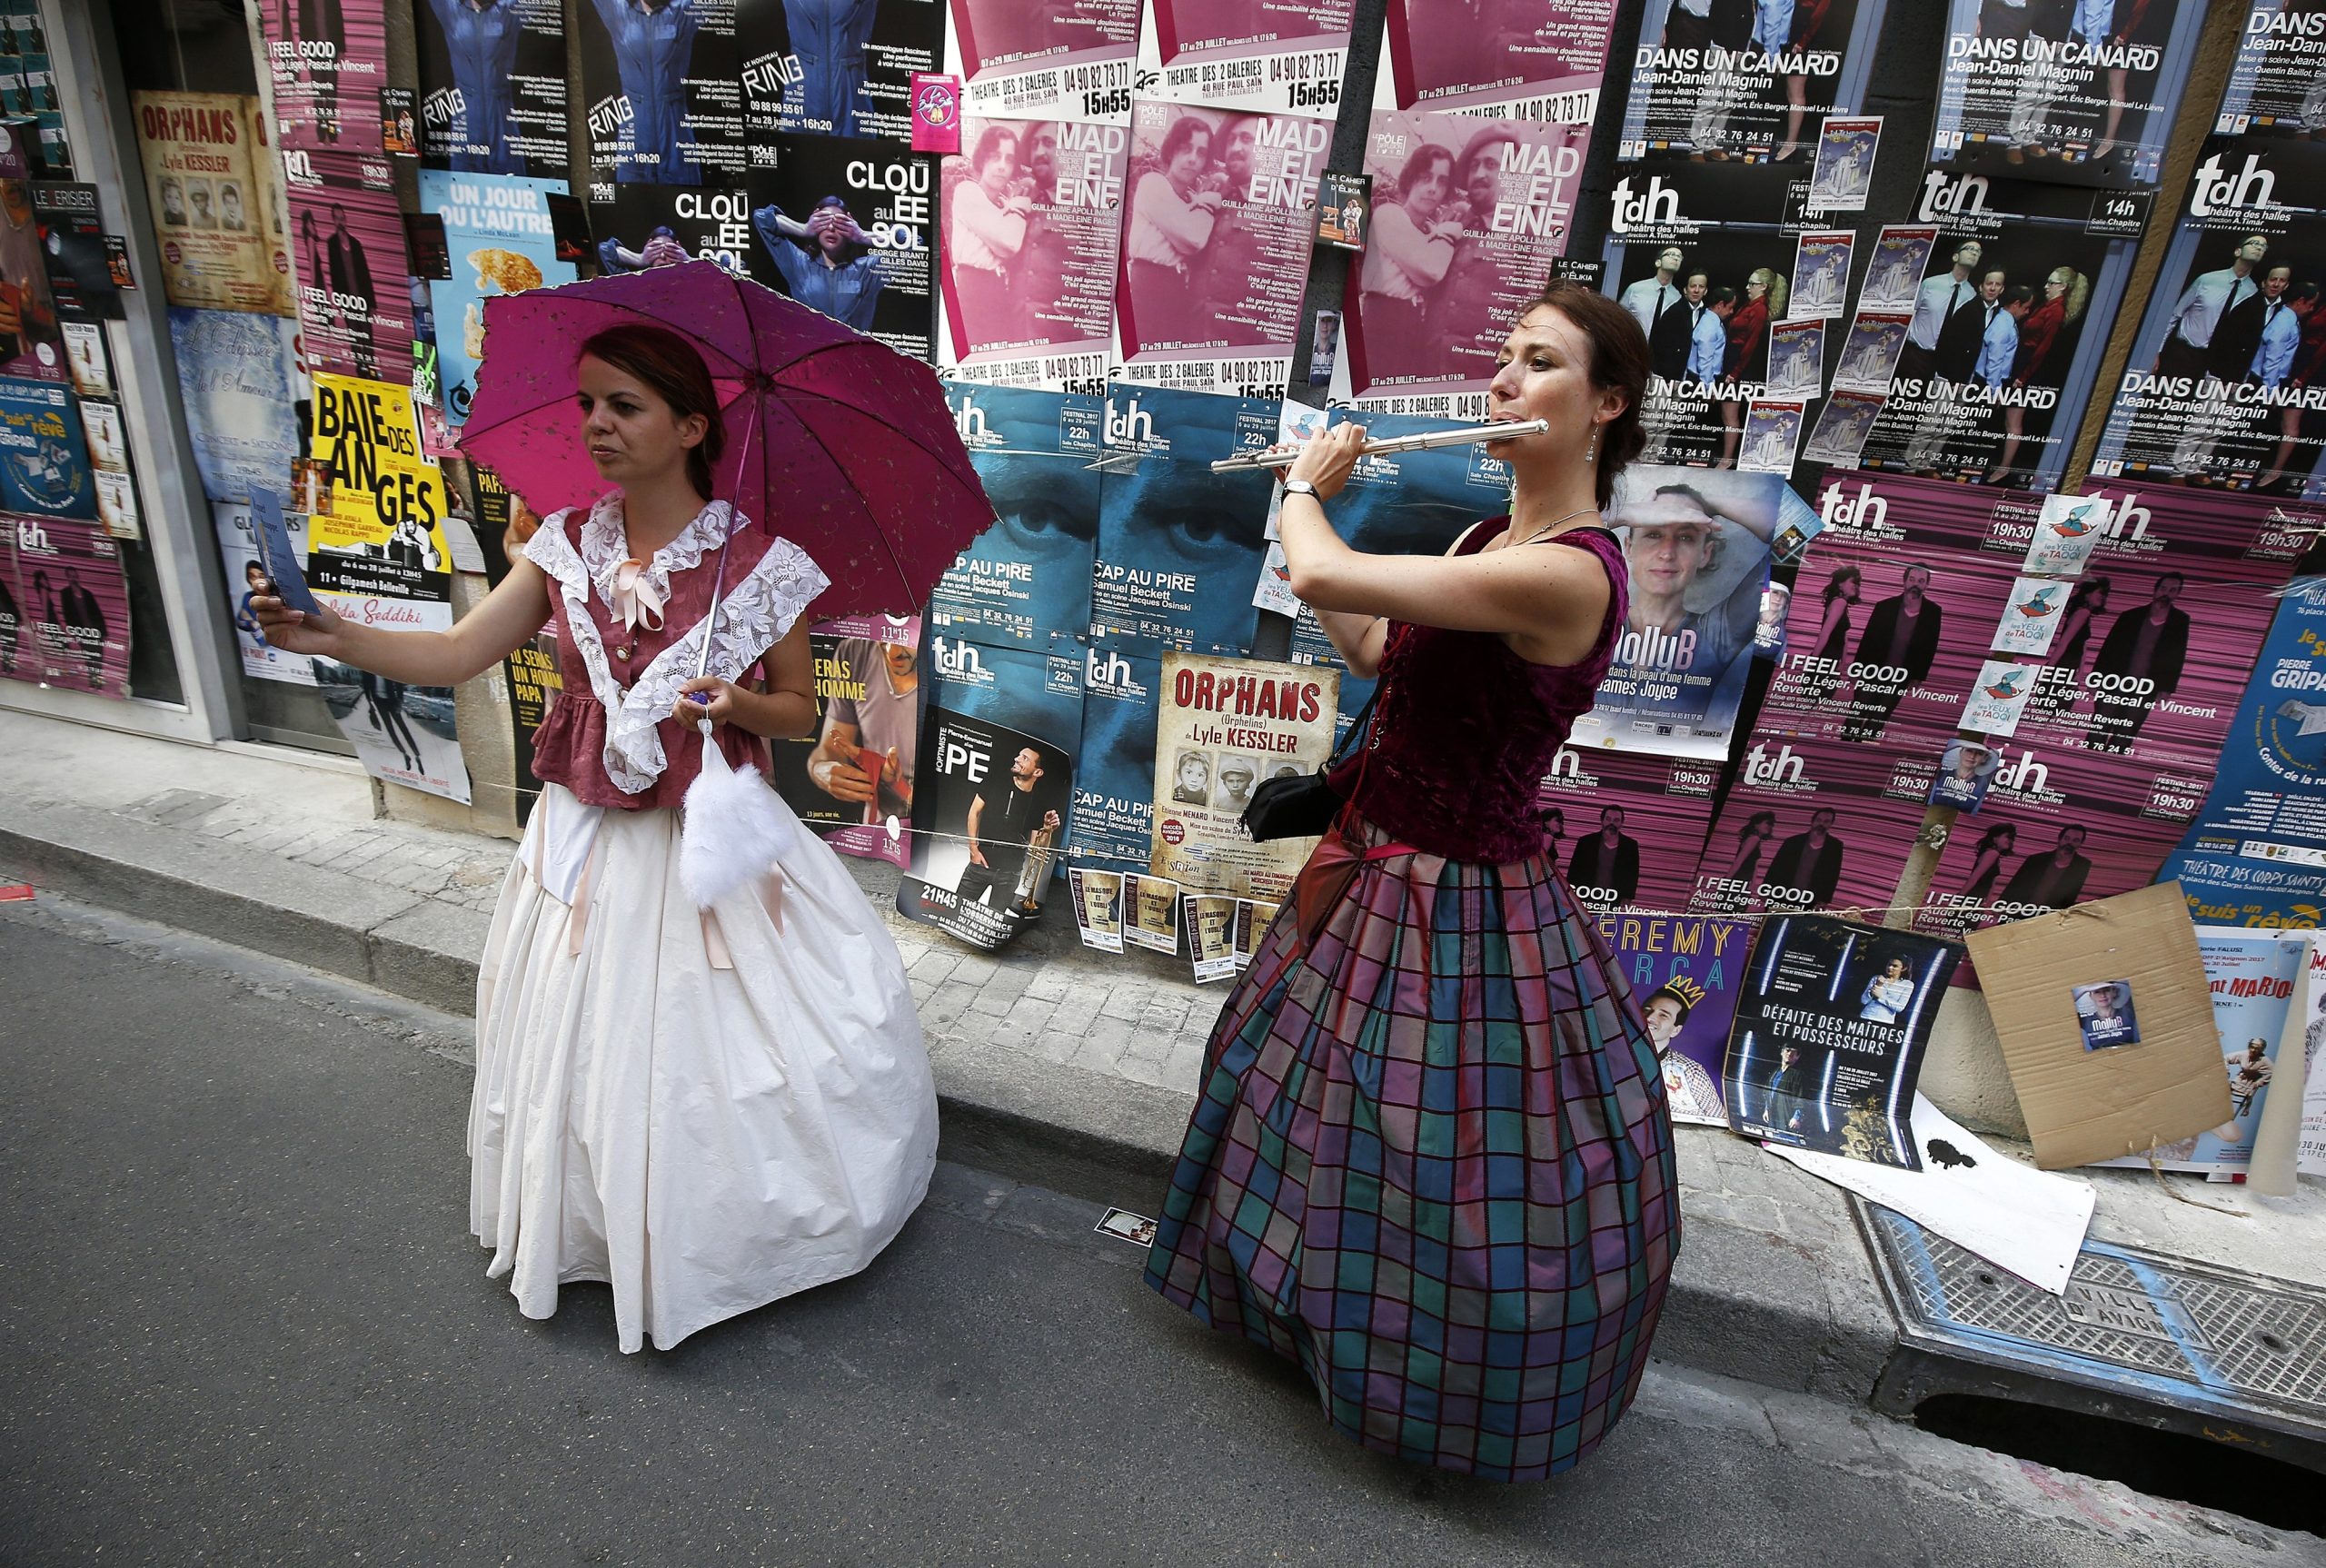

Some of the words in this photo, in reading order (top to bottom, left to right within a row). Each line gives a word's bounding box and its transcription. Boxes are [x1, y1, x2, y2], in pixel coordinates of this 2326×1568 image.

[273, 41, 297, 58] FEEL
[298, 41, 335, 59] GOOD
[751, 51, 779, 66] NOUVEAU
[871, 43, 903, 55] monologue
[898, 54, 932, 65] performance
[1948, 37, 2016, 60] DANS
[2022, 39, 2058, 62] UN
[2061, 42, 2159, 72] CANARD
[1167, 67, 1198, 86] THEATRE
[1202, 65, 1217, 82] DES
[1220, 64, 1225, 79] 2
[1227, 59, 1262, 79] GALERIES
[1270, 58, 1282, 82] 04
[1284, 56, 1296, 81] 90
[1298, 55, 1310, 79] 82
[1313, 54, 1324, 78] 73
[1327, 52, 1339, 77] 77
[1635, 48, 1698, 69] DANS
[1703, 50, 1735, 72] UN
[1740, 53, 1840, 76] CANARD
[1947, 57, 2035, 76] Jean-Daniel
[2038, 62, 2093, 82] Magnin
[741, 55, 805, 98] RING
[1202, 84, 1212, 92] 40
[1213, 82, 1226, 91] RUE
[1227, 80, 1245, 90] PAUL
[1247, 76, 1262, 88] SAÏN
[1633, 69, 1716, 85] Jean-Daniel
[1719, 74, 1773, 91] Magnin
[1675, 86, 1725, 97] Jean-Daniel
[1725, 89, 1758, 100] Magnin
[422, 87, 467, 130] RING
[1645, 96, 1671, 104] Quentin
[1696, 98, 1724, 107] Emeline
[1790, 104, 1815, 113] Manuel
[1827, 104, 1848, 114] Lièvre
[142, 104, 236, 145] ORPHANS
[587, 94, 634, 142] RING
[773, 116, 796, 127] juillet
[801, 119, 832, 132] 16h20
[1254, 116, 1327, 154] MAD
[184, 154, 231, 174] KESSLER
[1280, 150, 1320, 184] EL
[1500, 142, 1580, 178] MAD
[846, 161, 929, 194] CLOU
[1327, 173, 1337, 181] LE
[34, 190, 47, 204] LE
[450, 184, 481, 206] UN
[483, 186, 538, 211] JOUR
[1247, 174, 1319, 212] EINE
[1527, 175, 1571, 208] EL
[438, 205, 466, 226] OU
[874, 206, 893, 221] au
[894, 189, 929, 224] ÉE
[1221, 200, 1265, 213] GUILLAUME
[1265, 204, 1314, 220] APOLLINAIRE
[1611, 176, 1679, 233] tdh
[2105, 199, 2135, 216] 14h
[1243, 212, 1286, 224] MADELEINE
[1491, 203, 1568, 238] EINE
[1656, 225, 1672, 233] des
[1673, 224, 1699, 234] halles
[2091, 218, 2106, 226] Salle
[2107, 218, 2141, 228] Chapitre
[479, 229, 497, 237] Linda
[871, 222, 929, 252] SOL
[868, 248, 899, 258] GEORGE
[900, 251, 924, 260] BRANT
[880, 256, 906, 266] GILLES
[907, 259, 929, 268] DAVID
[1557, 260, 1567, 268] LE
[891, 276, 911, 284] Pauline
[1266, 284, 1300, 295] merveilleux
[307, 287, 331, 307] FEEL
[332, 292, 367, 313] GOOD
[1267, 333, 1292, 343] Télérama
[319, 387, 389, 447] BAIE
[1102, 397, 1152, 445] tdh
[387, 426, 414, 456] DES
[1244, 432, 1267, 446] 22h
[331, 438, 378, 493] AN
[375, 472, 435, 532] GES
[1820, 481, 1888, 533] tdh
[1992, 522, 2033, 539] 19h30
[320, 572, 330, 583] 11
[340, 574, 377, 590] Gilgamesh
[379, 581, 409, 595] Belleville
[1128, 569, 1151, 586] AU
[1156, 574, 1196, 592] PIRE
[1128, 594, 1160, 608] Jacques
[1162, 599, 1192, 611] Osinski
[1130, 584, 1171, 600] Beckett
[364, 599, 422, 624] Seddiki
[523, 648, 553, 670] SERAS
[1780, 652, 1788, 669] I
[1791, 654, 1841, 676] FEEL
[1847, 662, 1909, 683] GOOD
[2276, 659, 2312, 670] PIERRE
[1608, 665, 1628, 678] dans
[1629, 667, 1637, 679] la
[1638, 670, 1658, 680] peau
[1660, 670, 1682, 683] d'une
[1684, 672, 1712, 686] femme
[2085, 671, 2155, 696] GOOD
[515, 683, 542, 703] PAPA
[1175, 669, 1321, 723] ORPHANS
[1640, 680, 1678, 701] Joyce
[1773, 681, 1821, 697] Reverte
[1776, 670, 1811, 685] Aude
[1813, 674, 1851, 690] Léger,
[1854, 680, 1896, 696] Pascal
[1911, 687, 1960, 704] Vincent
[1818, 697, 1852, 708] Vincent
[1853, 700, 1887, 713] Reverte
[2048, 684, 2090, 701] Léger,
[2094, 690, 2142, 709] Pascal
[2143, 700, 2155, 710] et
[2160, 699, 2217, 719] Vincent
[1221, 714, 1267, 729] (Orphelins)
[948, 729, 993, 748] Pierre-Emmanuel
[1193, 724, 1222, 747] Lyle
[1227, 728, 1297, 753] KESSLER
[945, 743, 990, 784] PE
[2152, 793, 2195, 811] 19h30
[1183, 809, 1208, 821] MENARD
[1212, 814, 1235, 825] Vincent
[2183, 859, 2229, 878] THÉÂTRE
[2231, 867, 2251, 881] DES
[2252, 870, 2286, 885] CORPS
[920, 884, 959, 909] 21H45
[1696, 876, 1704, 888] I
[1706, 876, 1752, 895] FEEL
[1756, 883, 1815, 904] GOOD
[959, 906, 1014, 931] L'OBSERVANCE
[962, 898, 994, 918] THÉÂTRE
[1206, 910, 1227, 919] MASQUE
[2195, 903, 2239, 919] suis
[1763, 1003, 1815, 1031] DÉFAITE
[1818, 1015, 1844, 1032] DES
[1846, 1020, 1905, 1045] MAÎTRES
[1773, 1022, 1790, 1037] ET
[1793, 1026, 1885, 1056] POSSESSEURS
[2077, 1286, 2165, 1317] VILLE
[2098, 1308, 2204, 1344] AVIGNON
